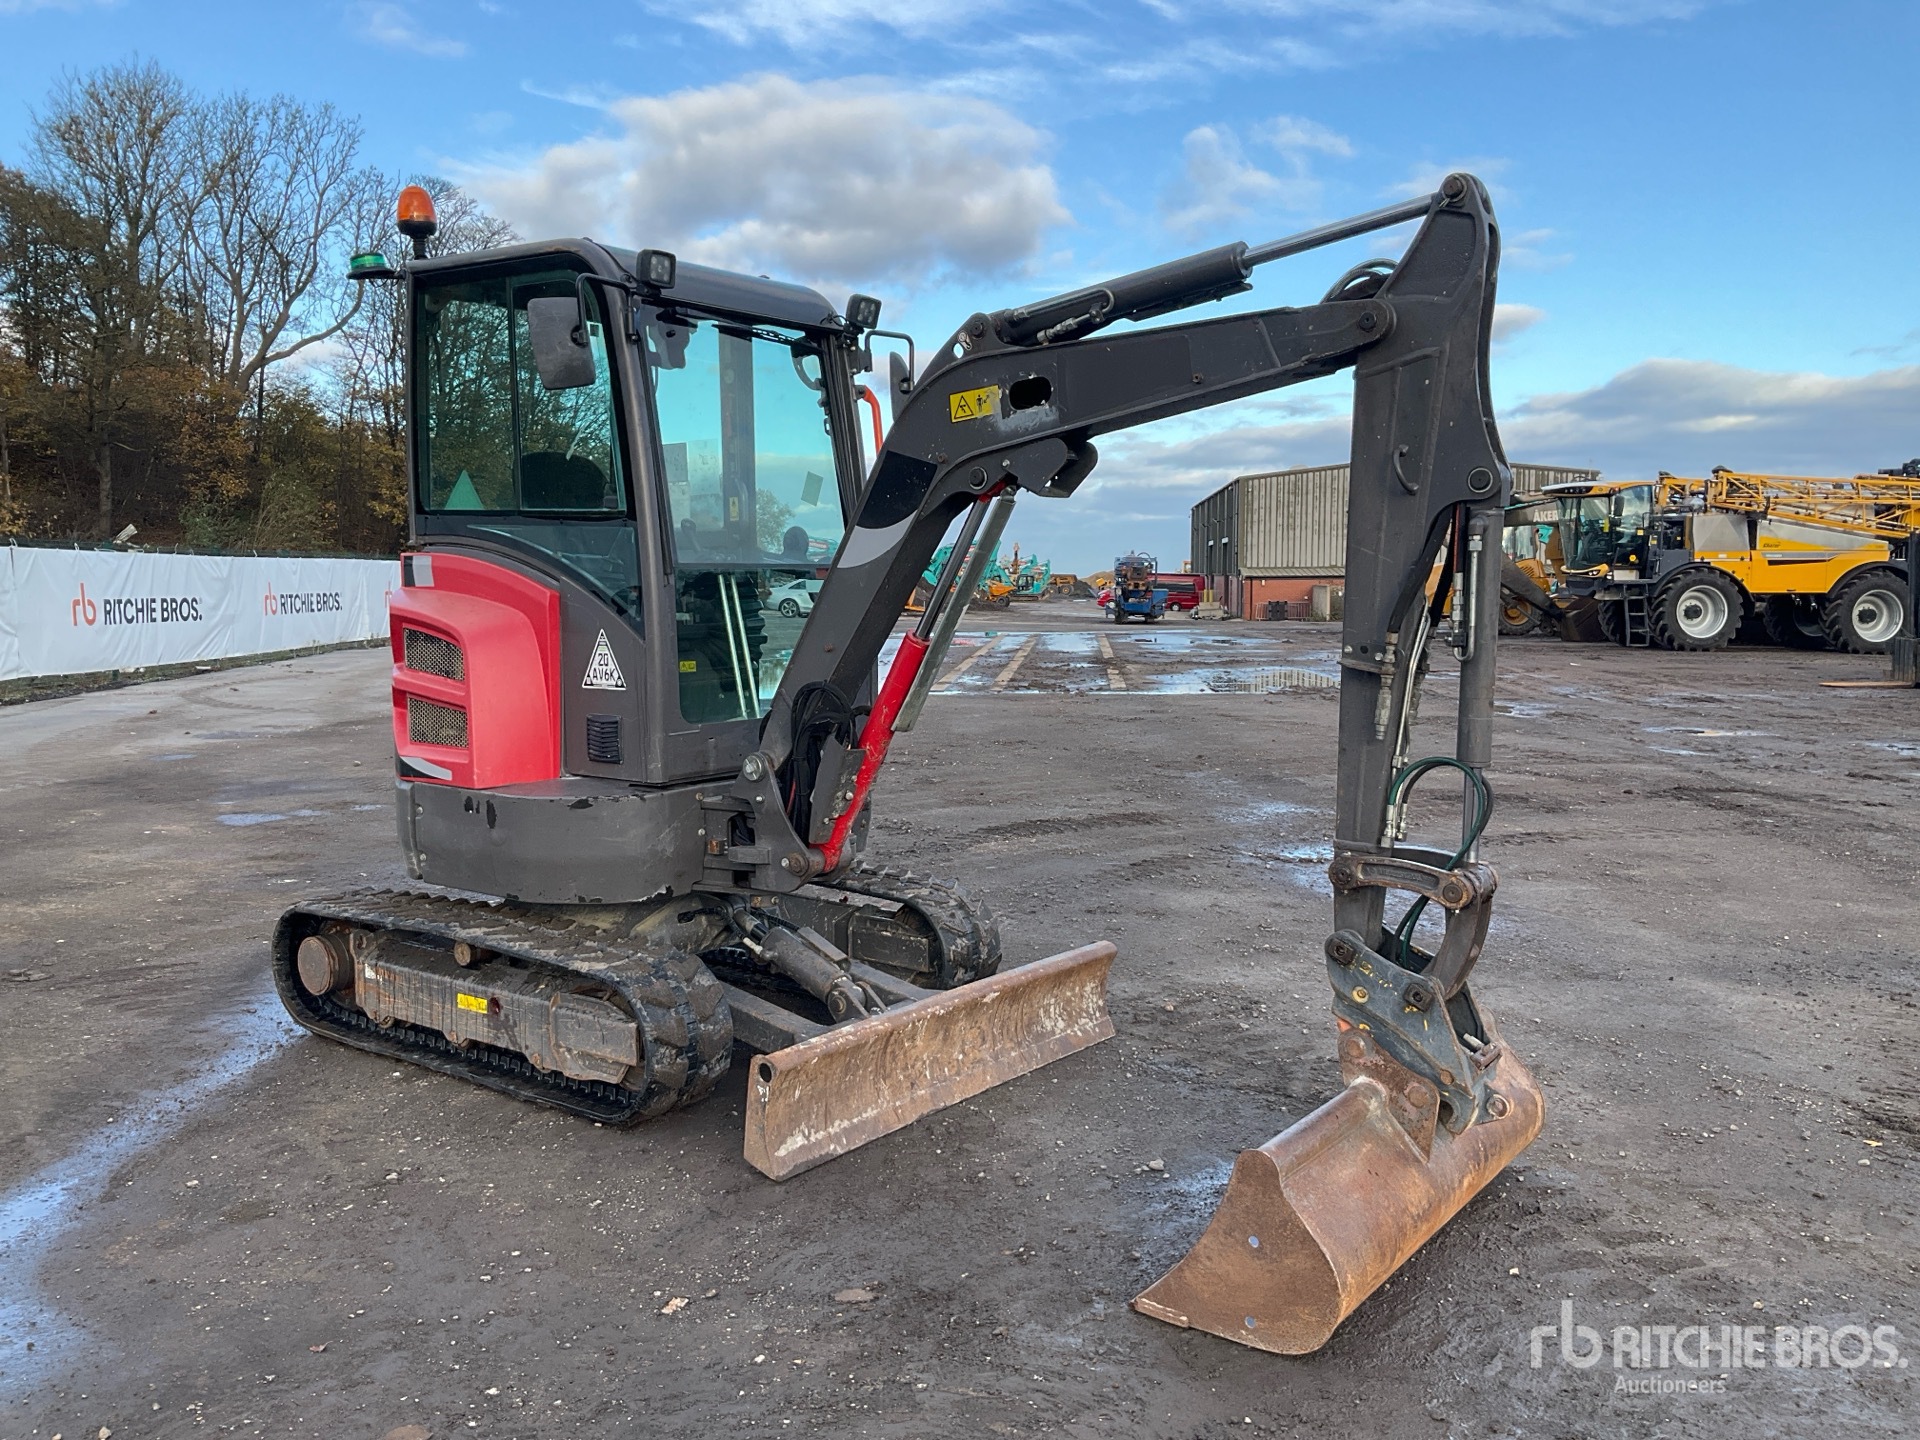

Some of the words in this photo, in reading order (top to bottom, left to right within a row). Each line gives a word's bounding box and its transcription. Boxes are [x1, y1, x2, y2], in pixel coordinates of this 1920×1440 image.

[103, 598, 157, 625] RITCHIE
[160, 597, 202, 622] BROS.
[280, 593, 315, 615] RITCHIE
[316, 592, 343, 612] BROS.
[592, 668, 616, 681] AV6K
